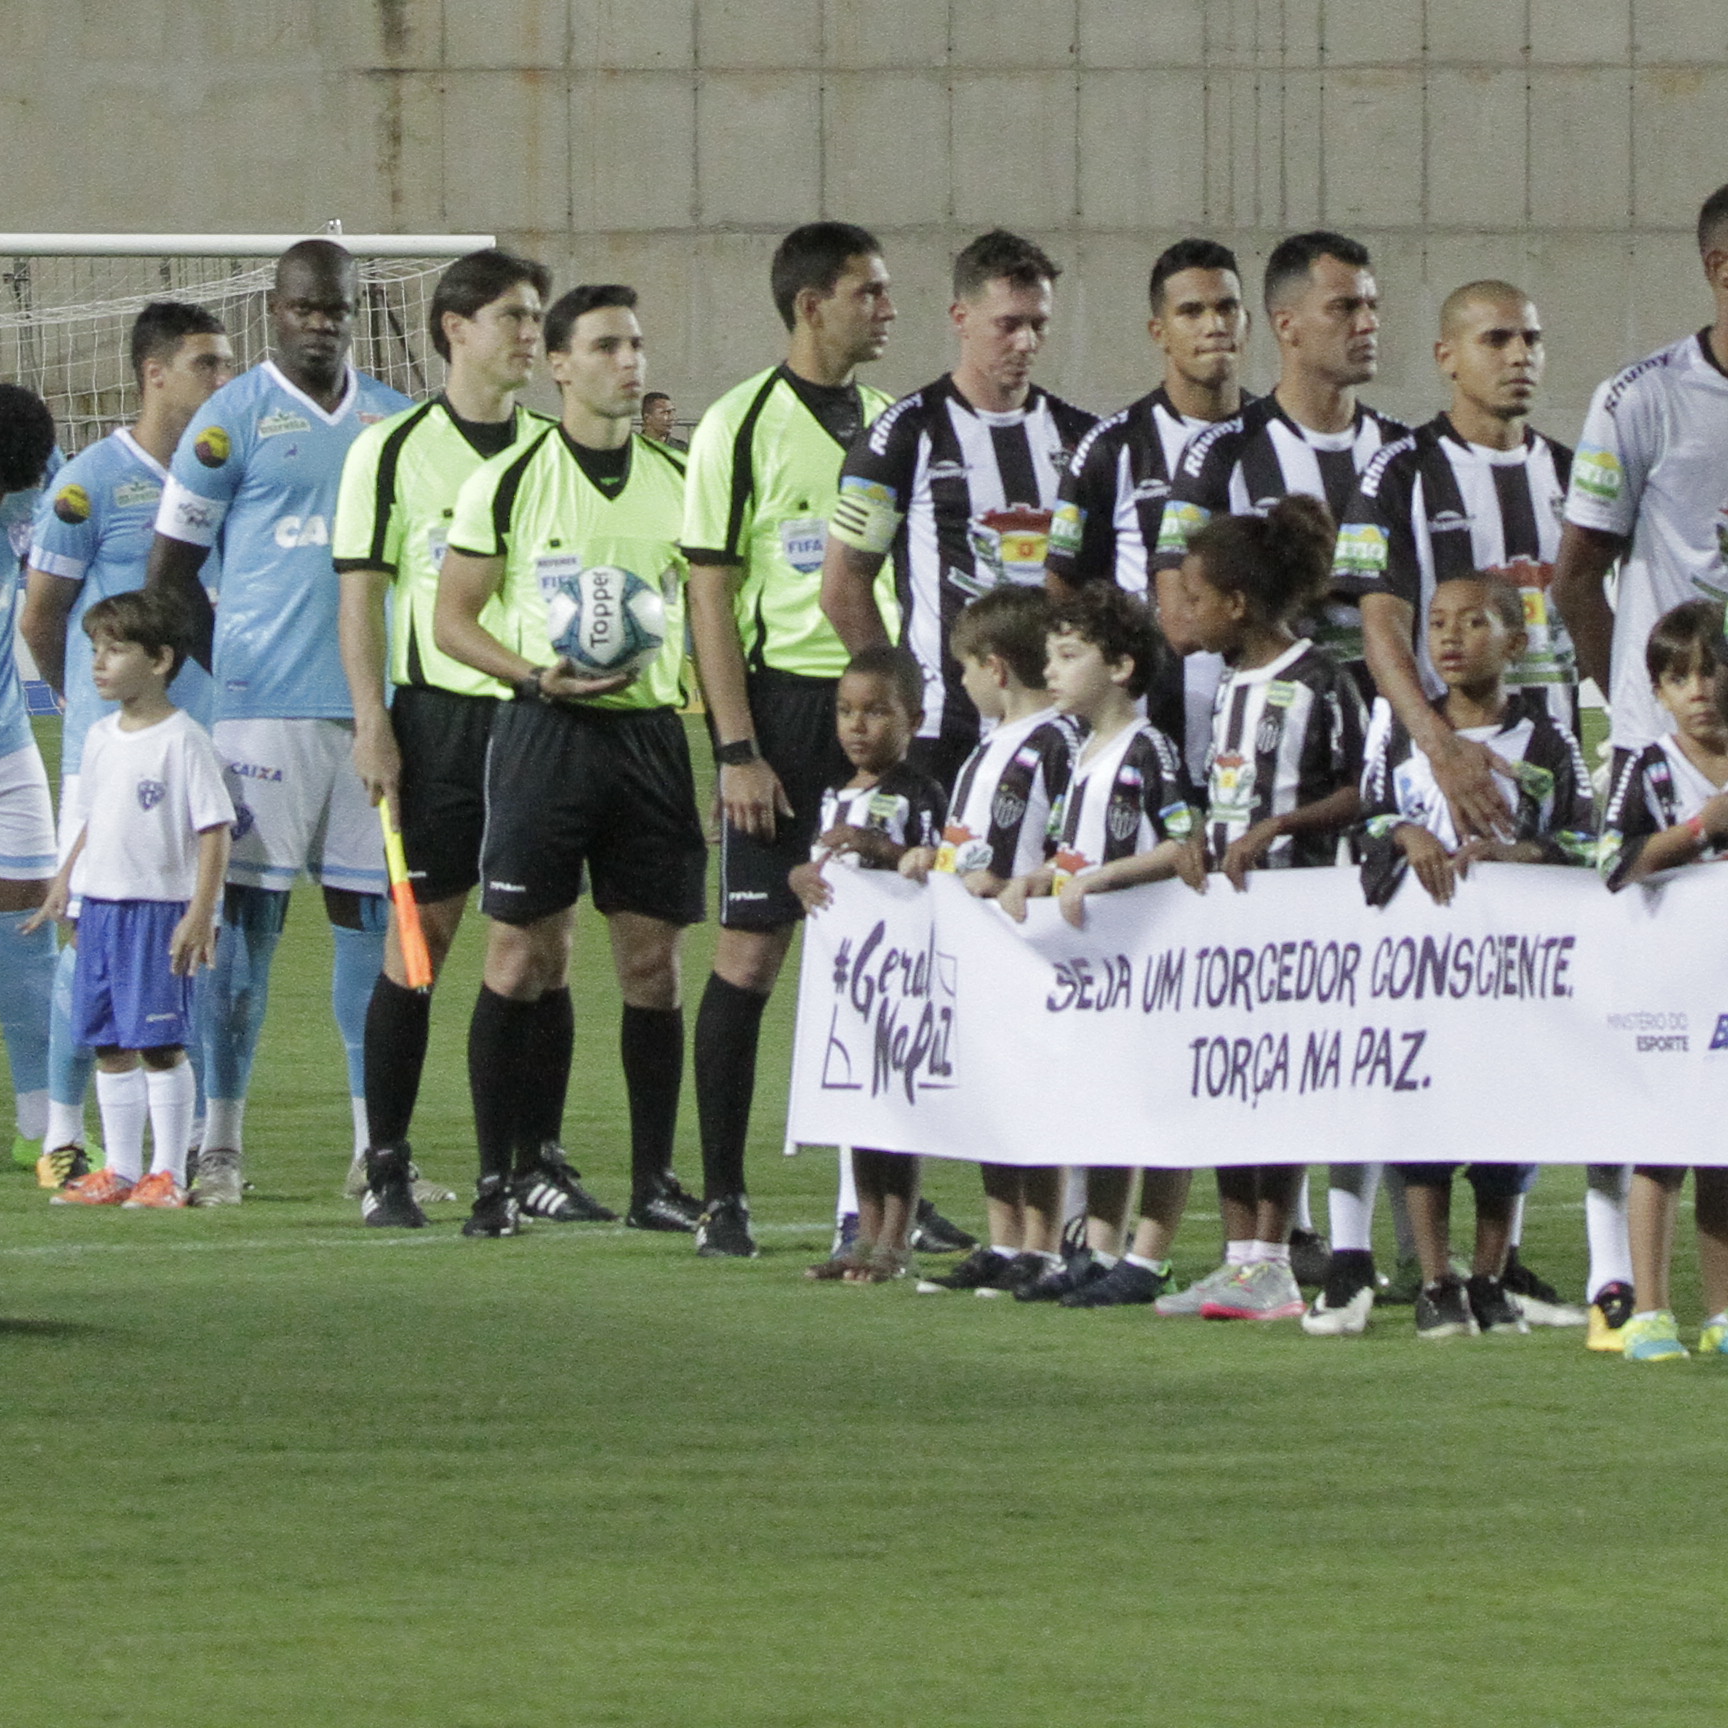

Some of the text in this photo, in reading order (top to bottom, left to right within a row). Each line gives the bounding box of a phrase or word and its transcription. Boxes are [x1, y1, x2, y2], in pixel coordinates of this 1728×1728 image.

[870, 393, 922, 455] Rhumy
[1183, 417, 1244, 478] Rhumy
[1361, 434, 1417, 498] Rhumy
[787, 540, 824, 554] FIFA
[590, 571, 613, 649] Topper
[230, 762, 282, 783] CAIXA
[834, 920, 936, 1022] #Geral
[1046, 954, 1132, 1012] SEJA
[1142, 947, 1186, 1014] UM
[1193, 939, 1361, 1013] TORCEDOR
[1189, 1026, 1432, 1110] TORÇA NA PAZ.
[1636, 1035, 1690, 1052] ESPORTE
